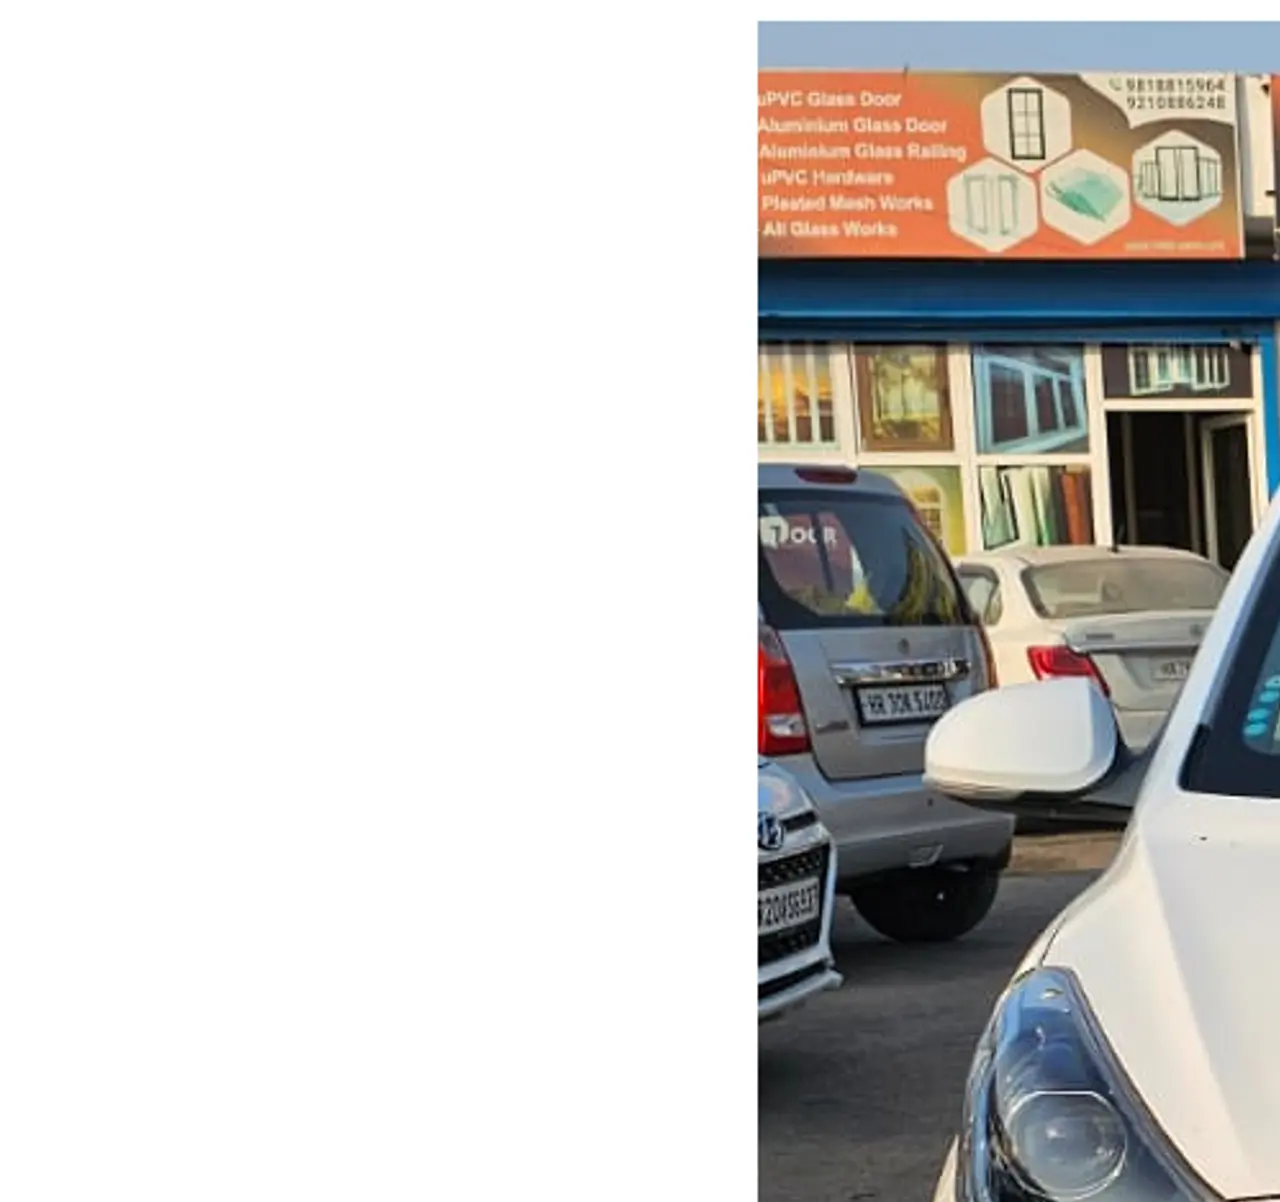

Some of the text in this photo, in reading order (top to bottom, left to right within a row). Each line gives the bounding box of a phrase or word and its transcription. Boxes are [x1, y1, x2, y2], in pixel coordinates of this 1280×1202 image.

[807, 91, 857, 107] Glass
[859, 91, 903, 107] Door
[758, 117, 948, 133] Aluminium Glass Door
[759, 143, 968, 163] Aluminium Glass Railing
[761, 169, 895, 186] uPVC Hardware
[828, 195, 877, 211] Mesh
[879, 195, 935, 211] Works
[762, 220, 898, 236] All Glass Works
